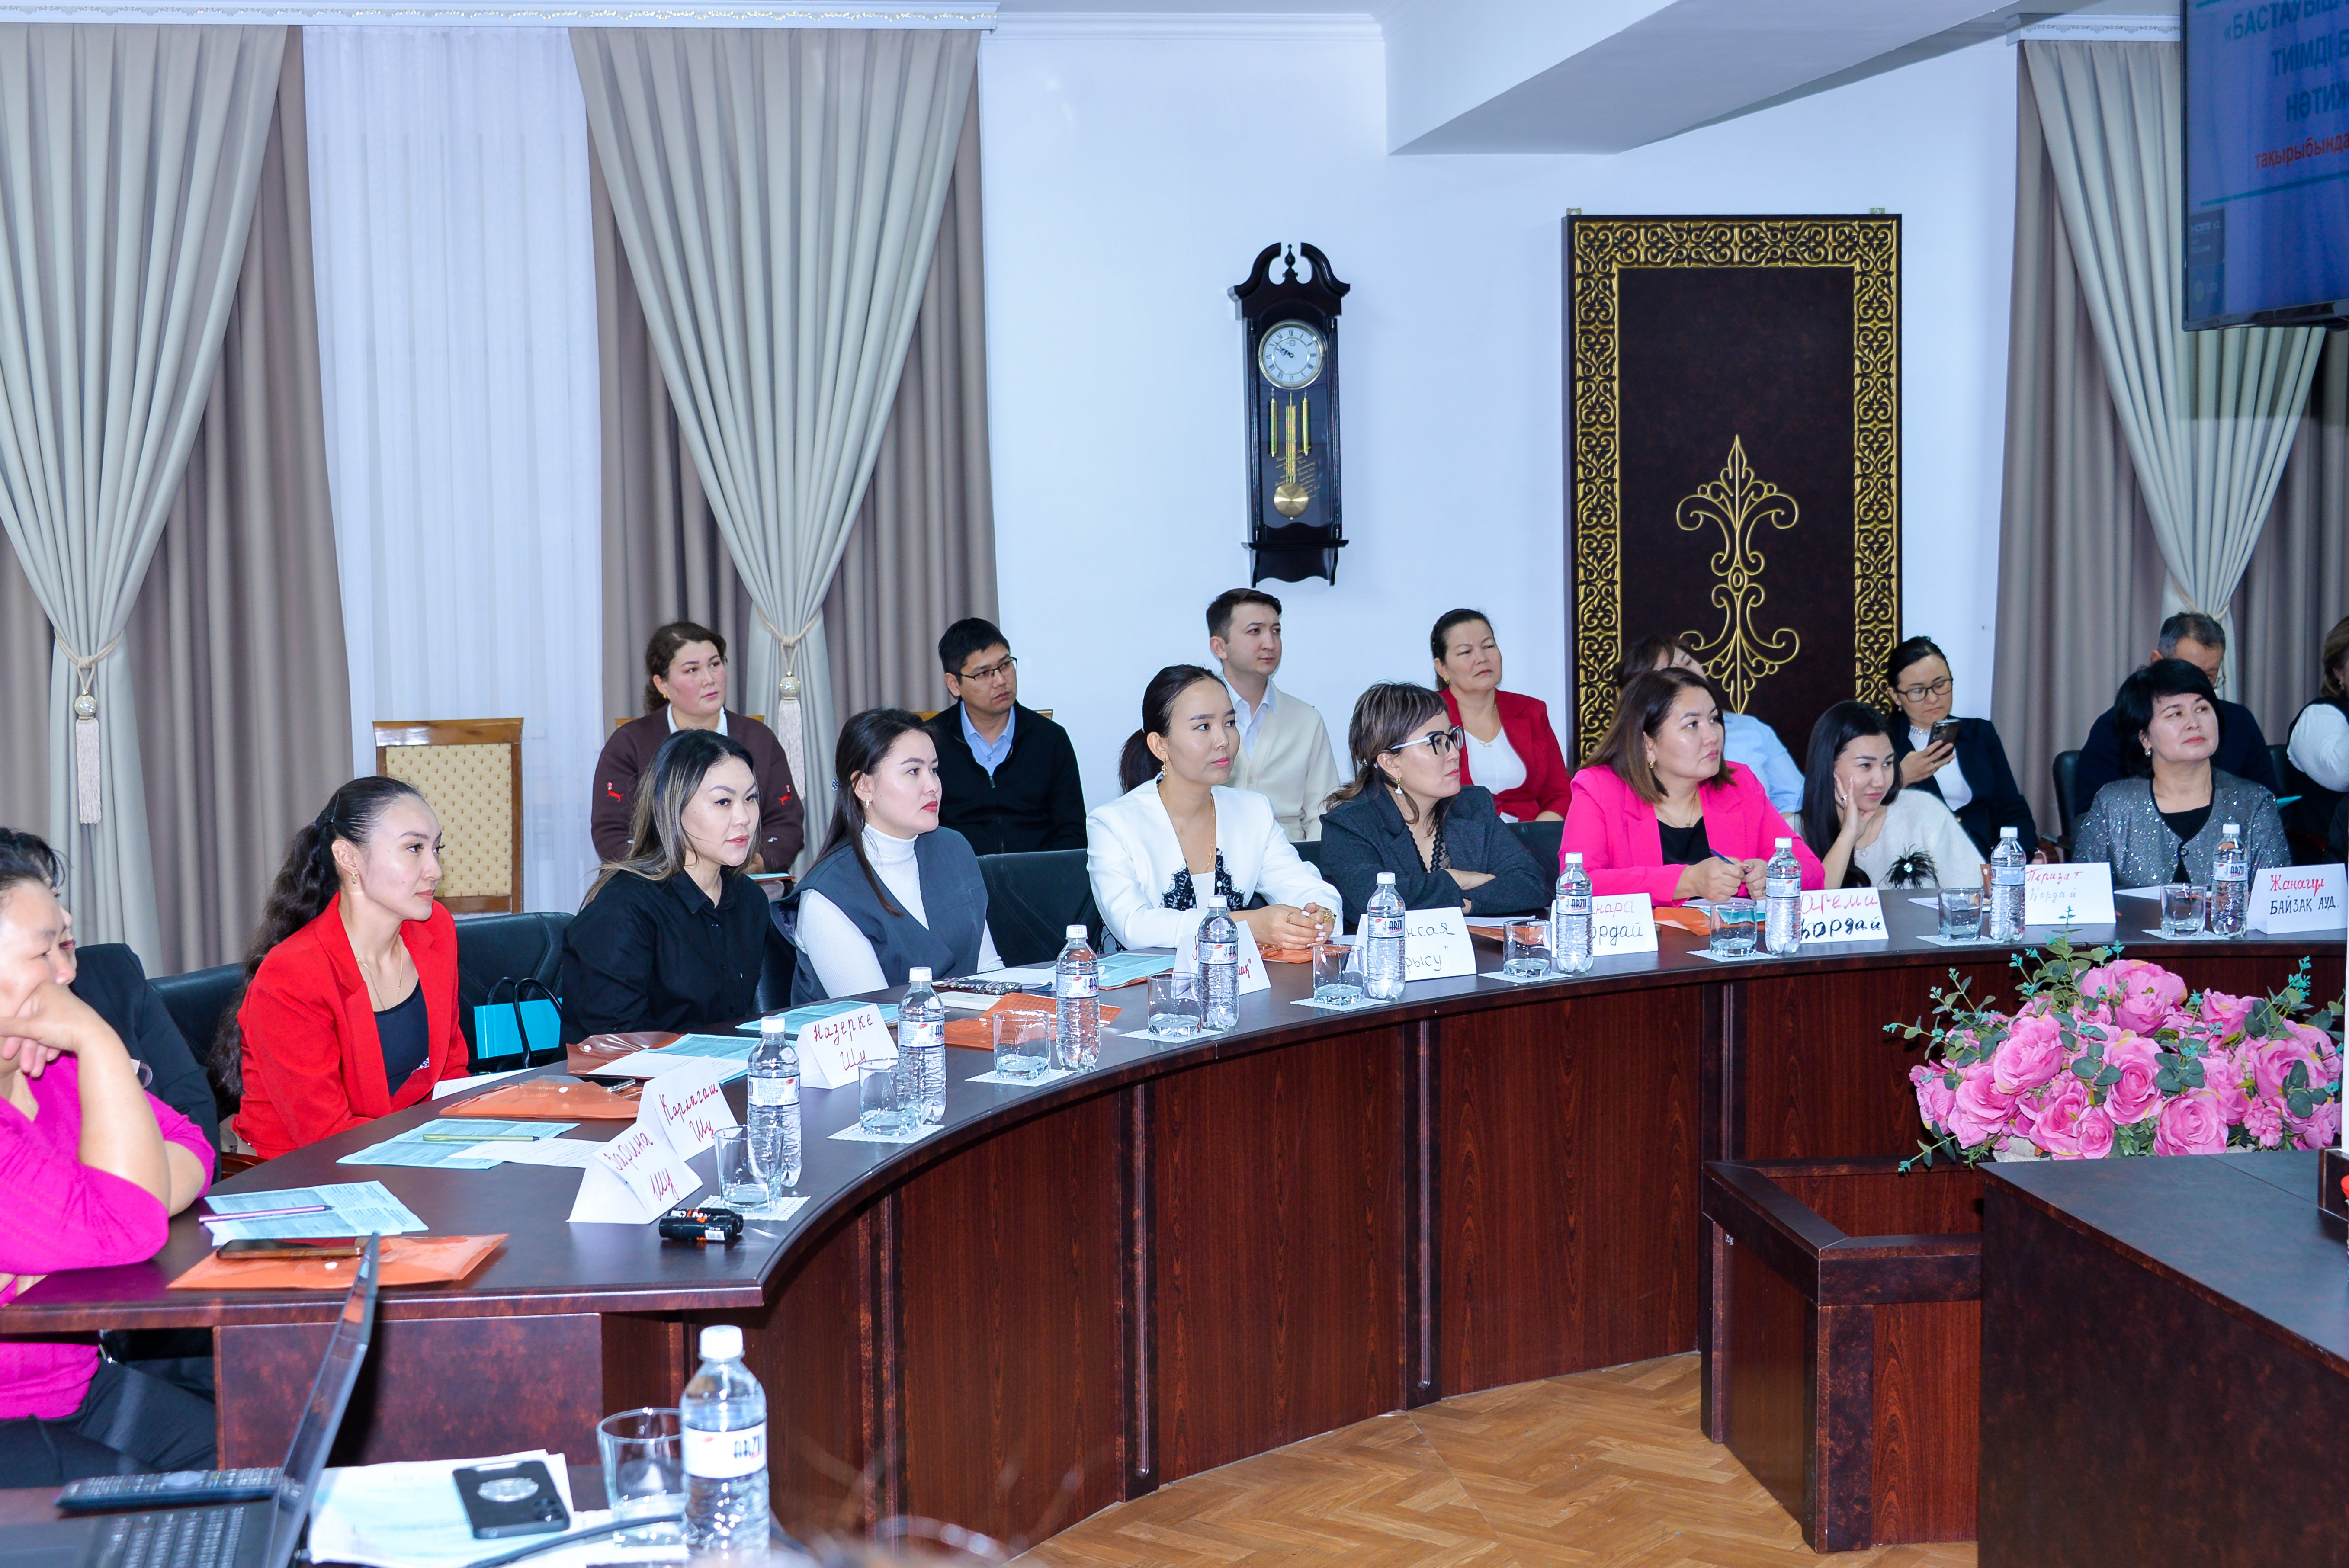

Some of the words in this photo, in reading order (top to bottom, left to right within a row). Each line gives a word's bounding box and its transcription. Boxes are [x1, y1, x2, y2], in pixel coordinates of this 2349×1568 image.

[1570, 898, 1586, 908] ARZU
[1592, 922, 1643, 946] ордай
[814, 1014, 873, 1045] Назерке
[603, 1132, 653, 1170] Зарина
